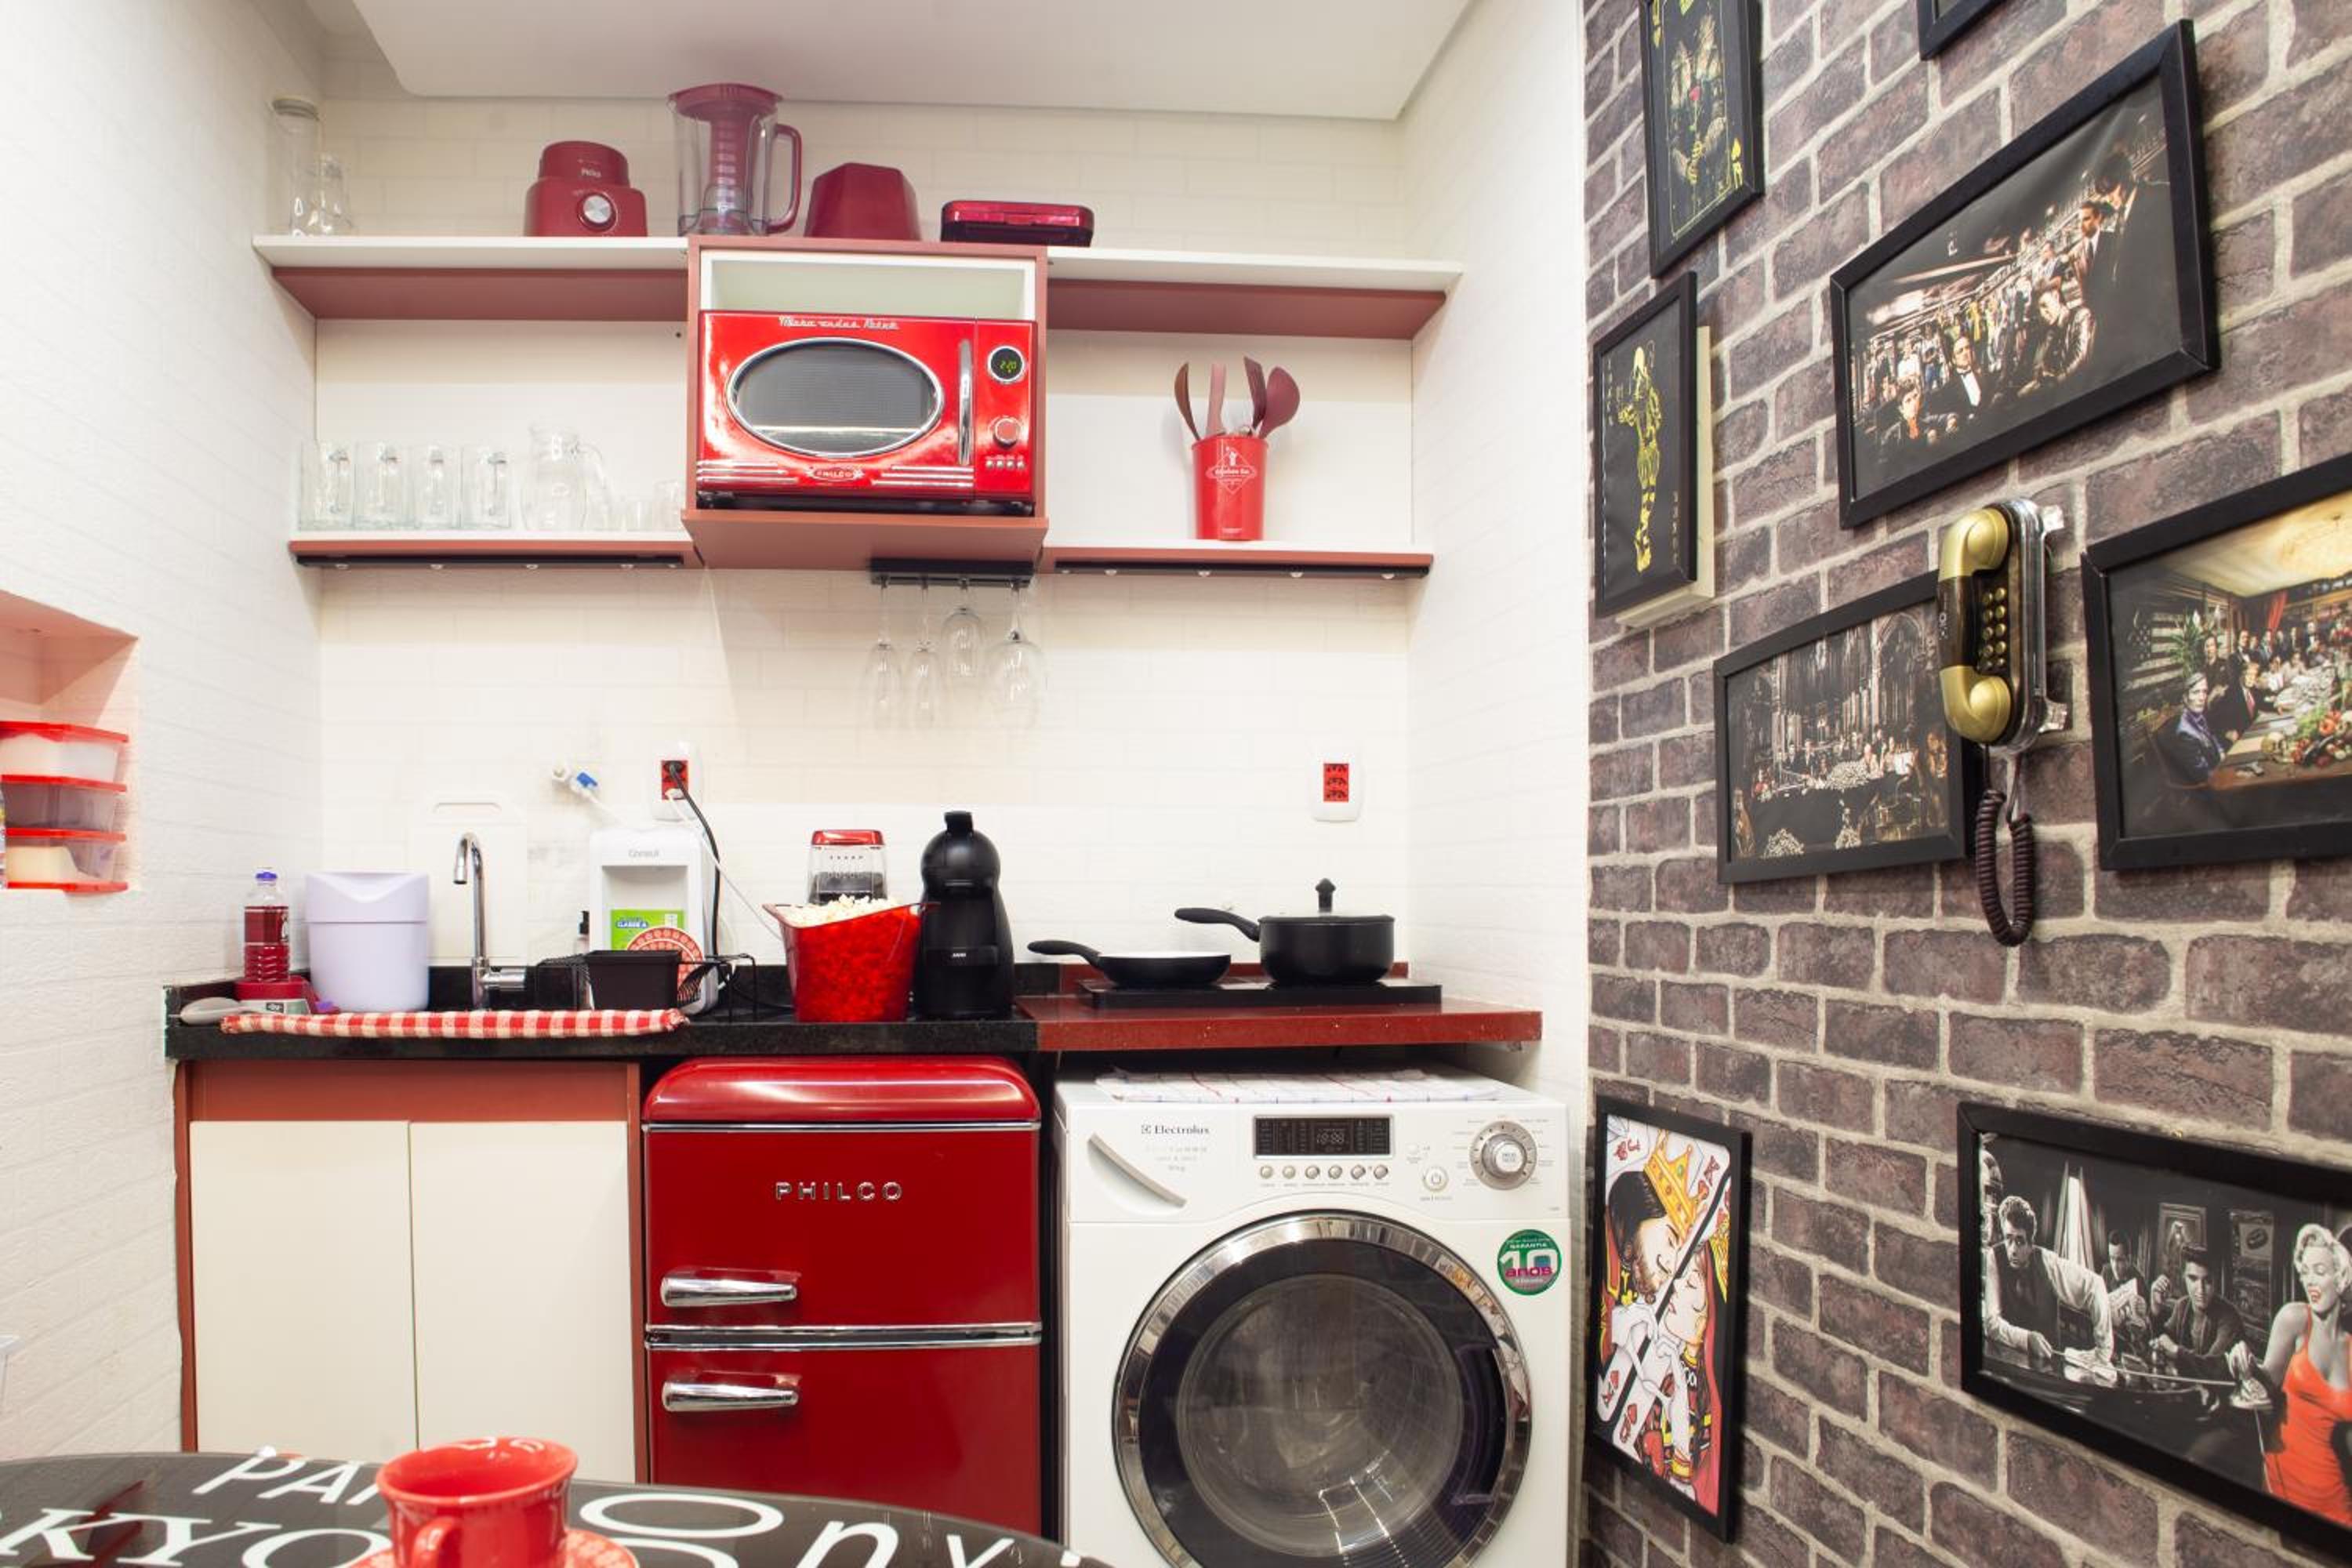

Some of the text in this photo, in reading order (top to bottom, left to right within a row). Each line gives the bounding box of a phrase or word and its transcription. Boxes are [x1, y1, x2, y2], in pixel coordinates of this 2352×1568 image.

[1155, 1124, 1210, 1134] Electrolux
[775, 1181, 902, 1201] PHILCO
[1505, 1267, 1552, 1278] anos
[193, 1446, 392, 1505] PA
